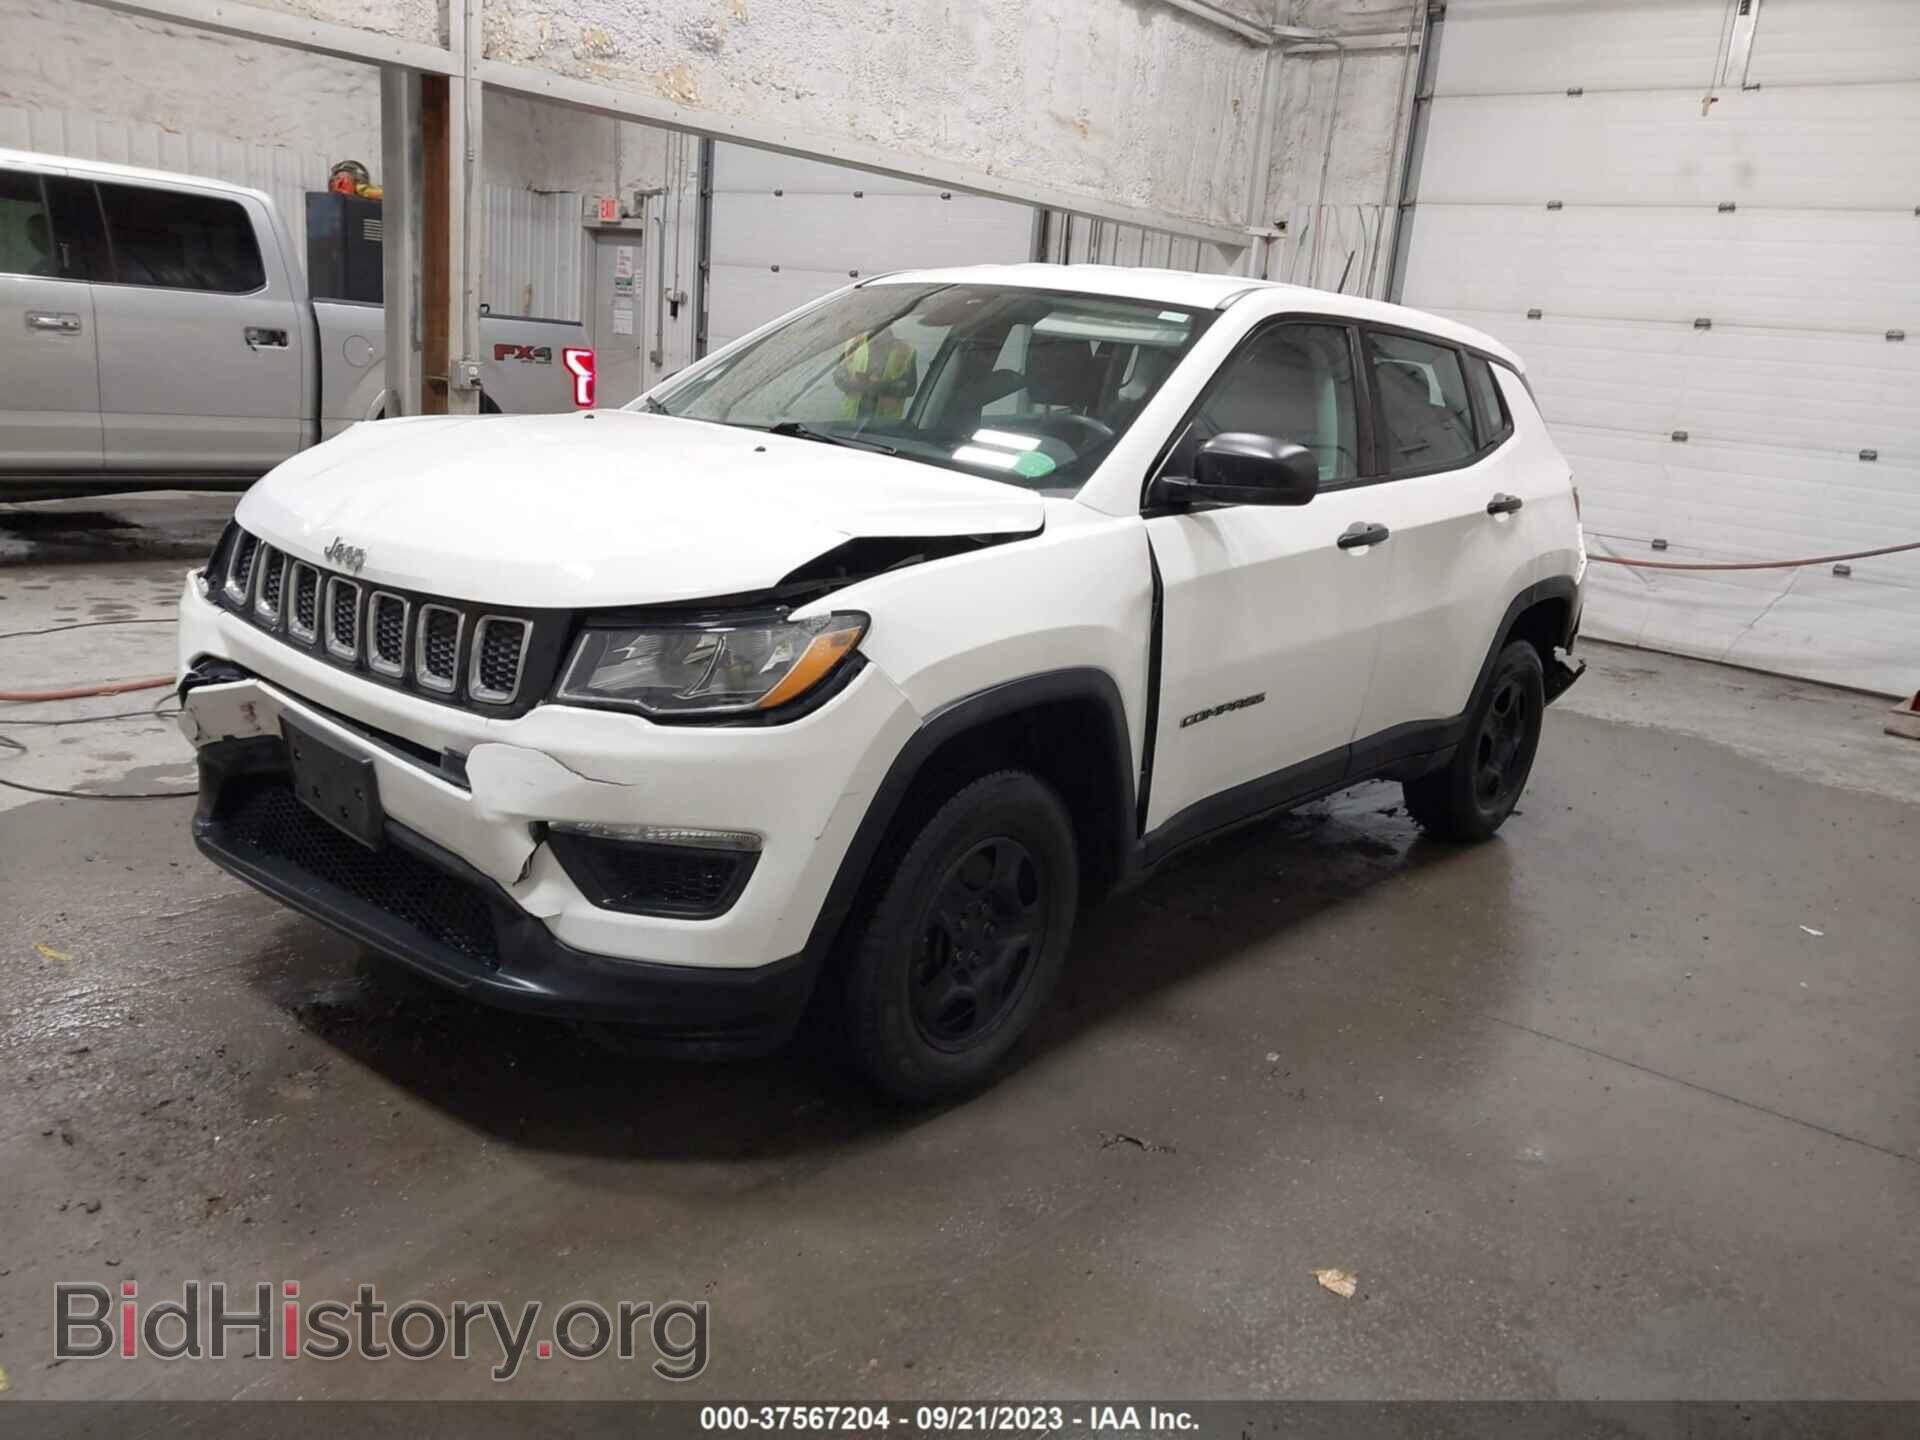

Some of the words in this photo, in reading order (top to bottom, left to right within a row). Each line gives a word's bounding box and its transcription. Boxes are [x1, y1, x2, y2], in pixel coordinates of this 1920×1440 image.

[495, 344, 552, 363] FX4
[324, 536, 365, 573] Jeep
[1180, 692, 1265, 728] COMPASS
